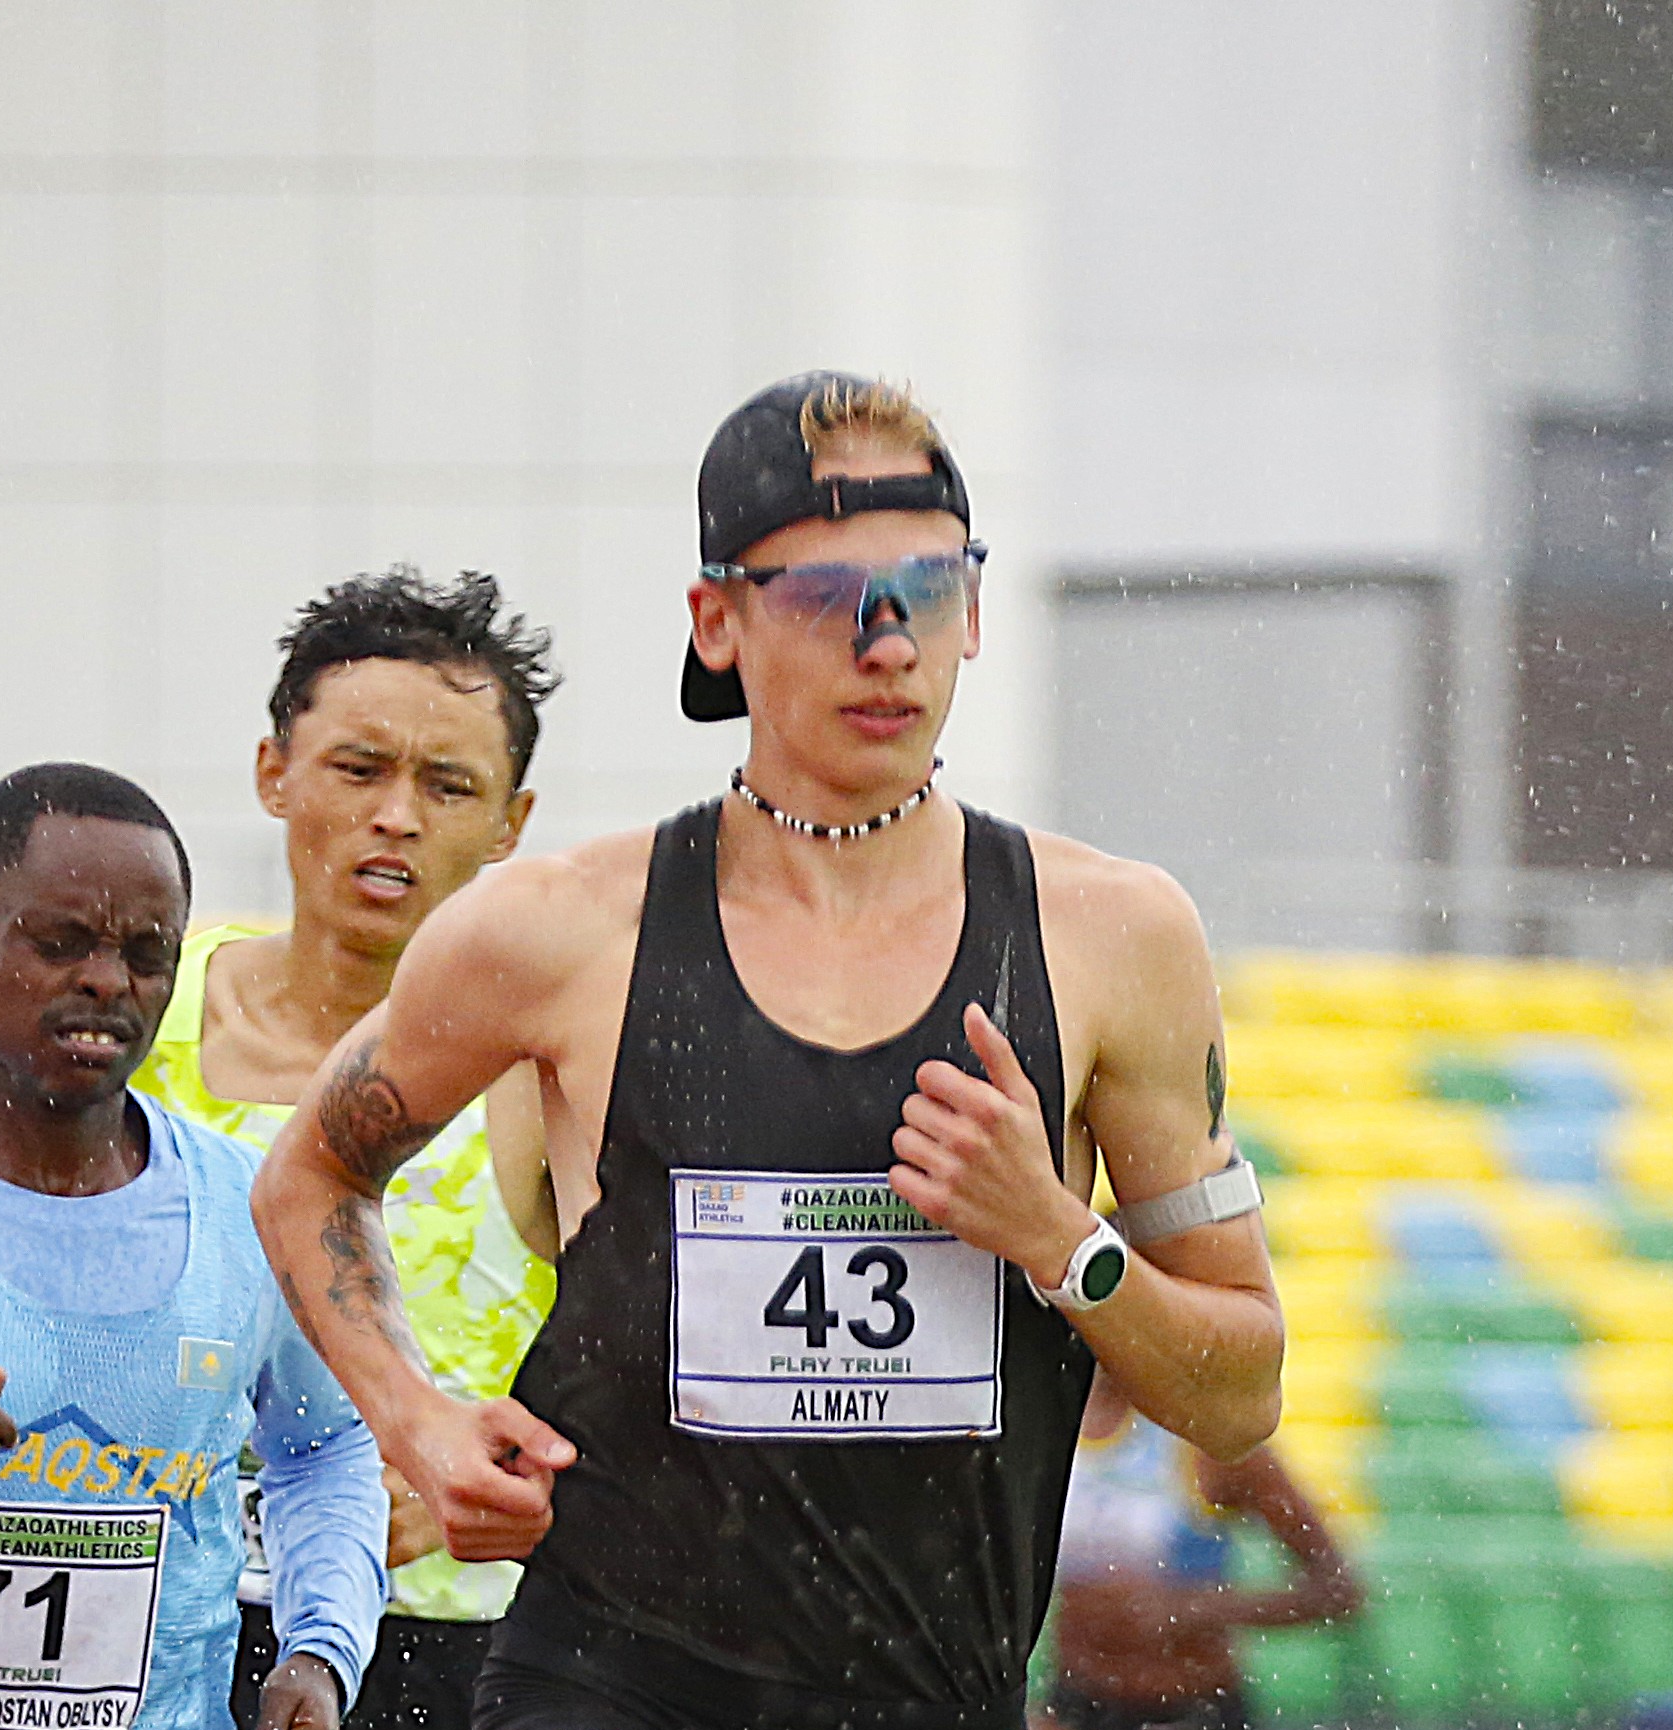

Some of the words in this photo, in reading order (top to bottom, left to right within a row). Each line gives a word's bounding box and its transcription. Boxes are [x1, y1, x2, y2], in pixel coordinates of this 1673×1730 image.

[763, 1245, 915, 1350] 43
[770, 1355, 830, 1374] PLAY
[840, 1357, 911, 1374] TRUE!
[791, 1390, 890, 1422] ALMATY
[56, 1700, 127, 1728] OBLYSY
